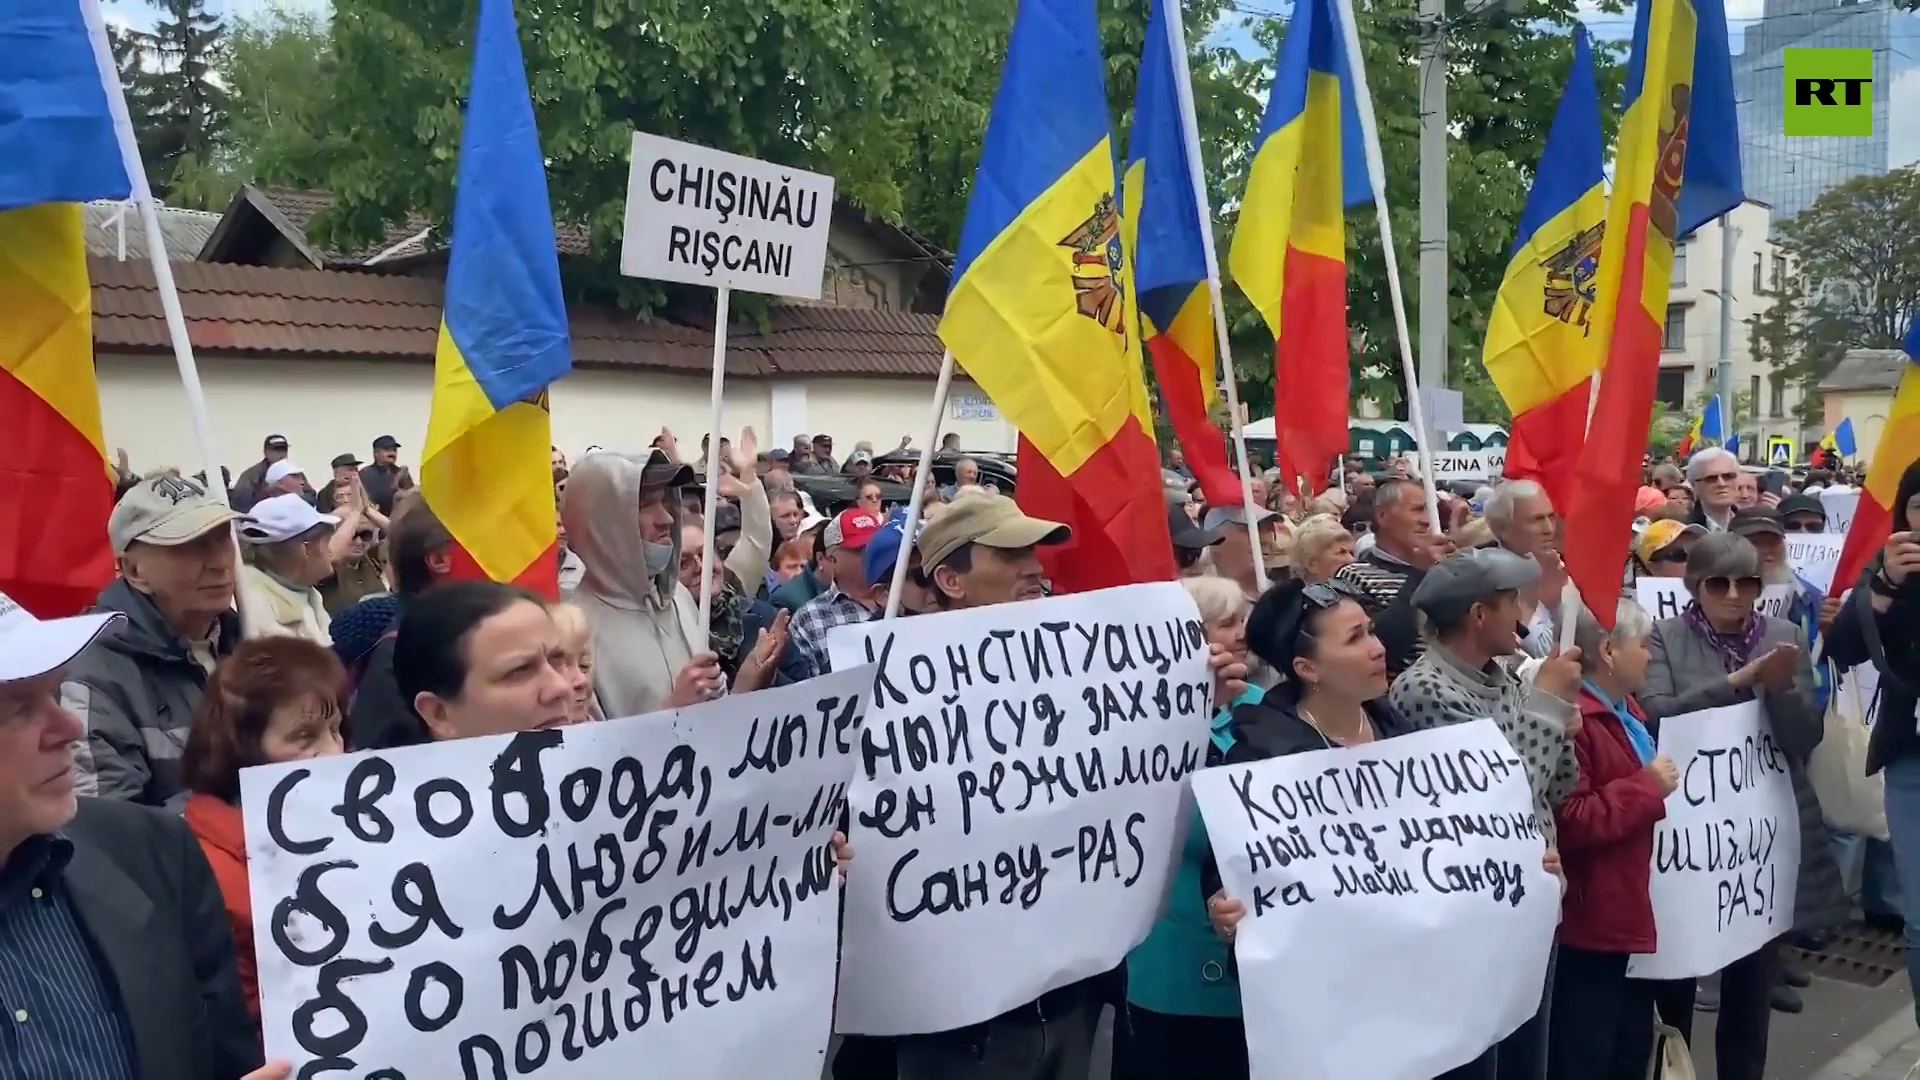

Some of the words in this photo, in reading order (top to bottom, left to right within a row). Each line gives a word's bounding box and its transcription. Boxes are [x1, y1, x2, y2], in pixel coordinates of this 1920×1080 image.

[668, 225, 793, 278] RIŞCANI
[861, 694, 974, 780] ный
[984, 694, 1065, 755] суд
[266, 728, 712, 855] Свобода,
[859, 784, 937, 838] ен
[1246, 823, 1316, 873] ный
[1253, 878, 1316, 917] ка
[1423, 846, 1525, 907] Санду
[1718, 863, 1775, 933] PAS!
